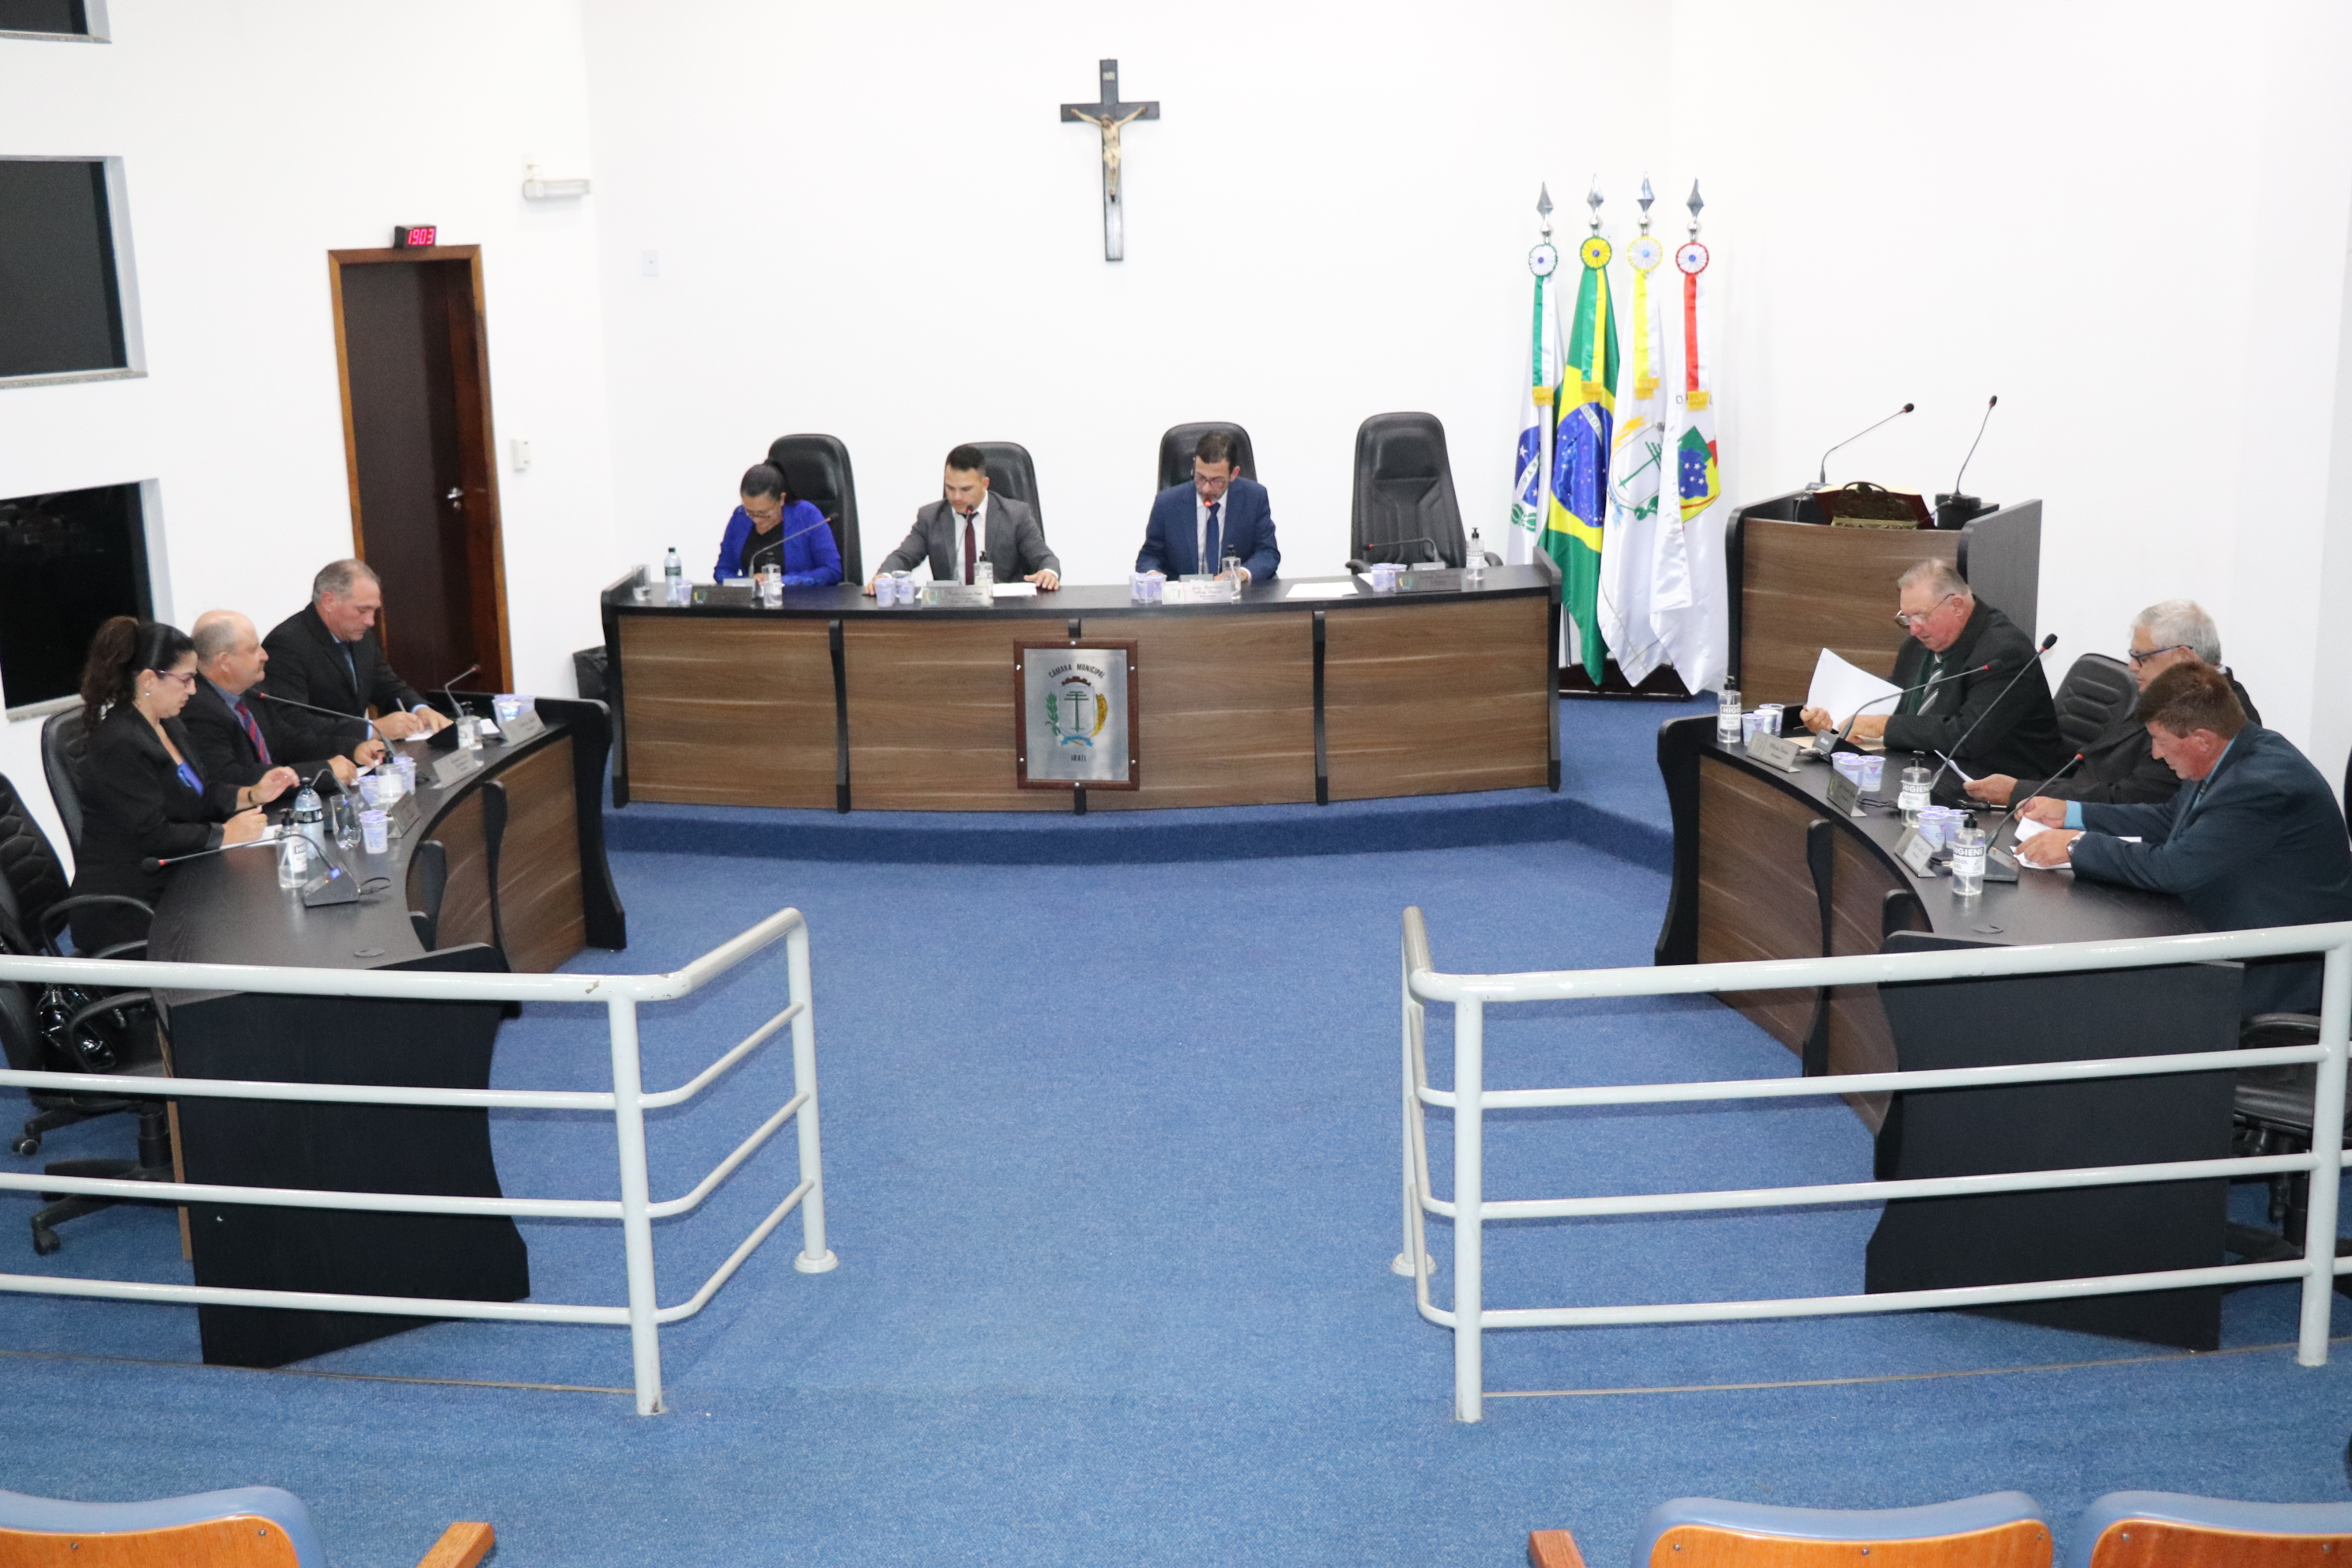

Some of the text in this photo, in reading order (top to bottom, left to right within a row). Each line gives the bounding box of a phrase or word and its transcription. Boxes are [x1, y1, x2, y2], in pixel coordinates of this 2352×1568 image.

[407, 228, 435, 245] 1903
[1076, 663, 1106, 679] MUNICIPAL
[1902, 784, 1931, 793] HIGIEN
